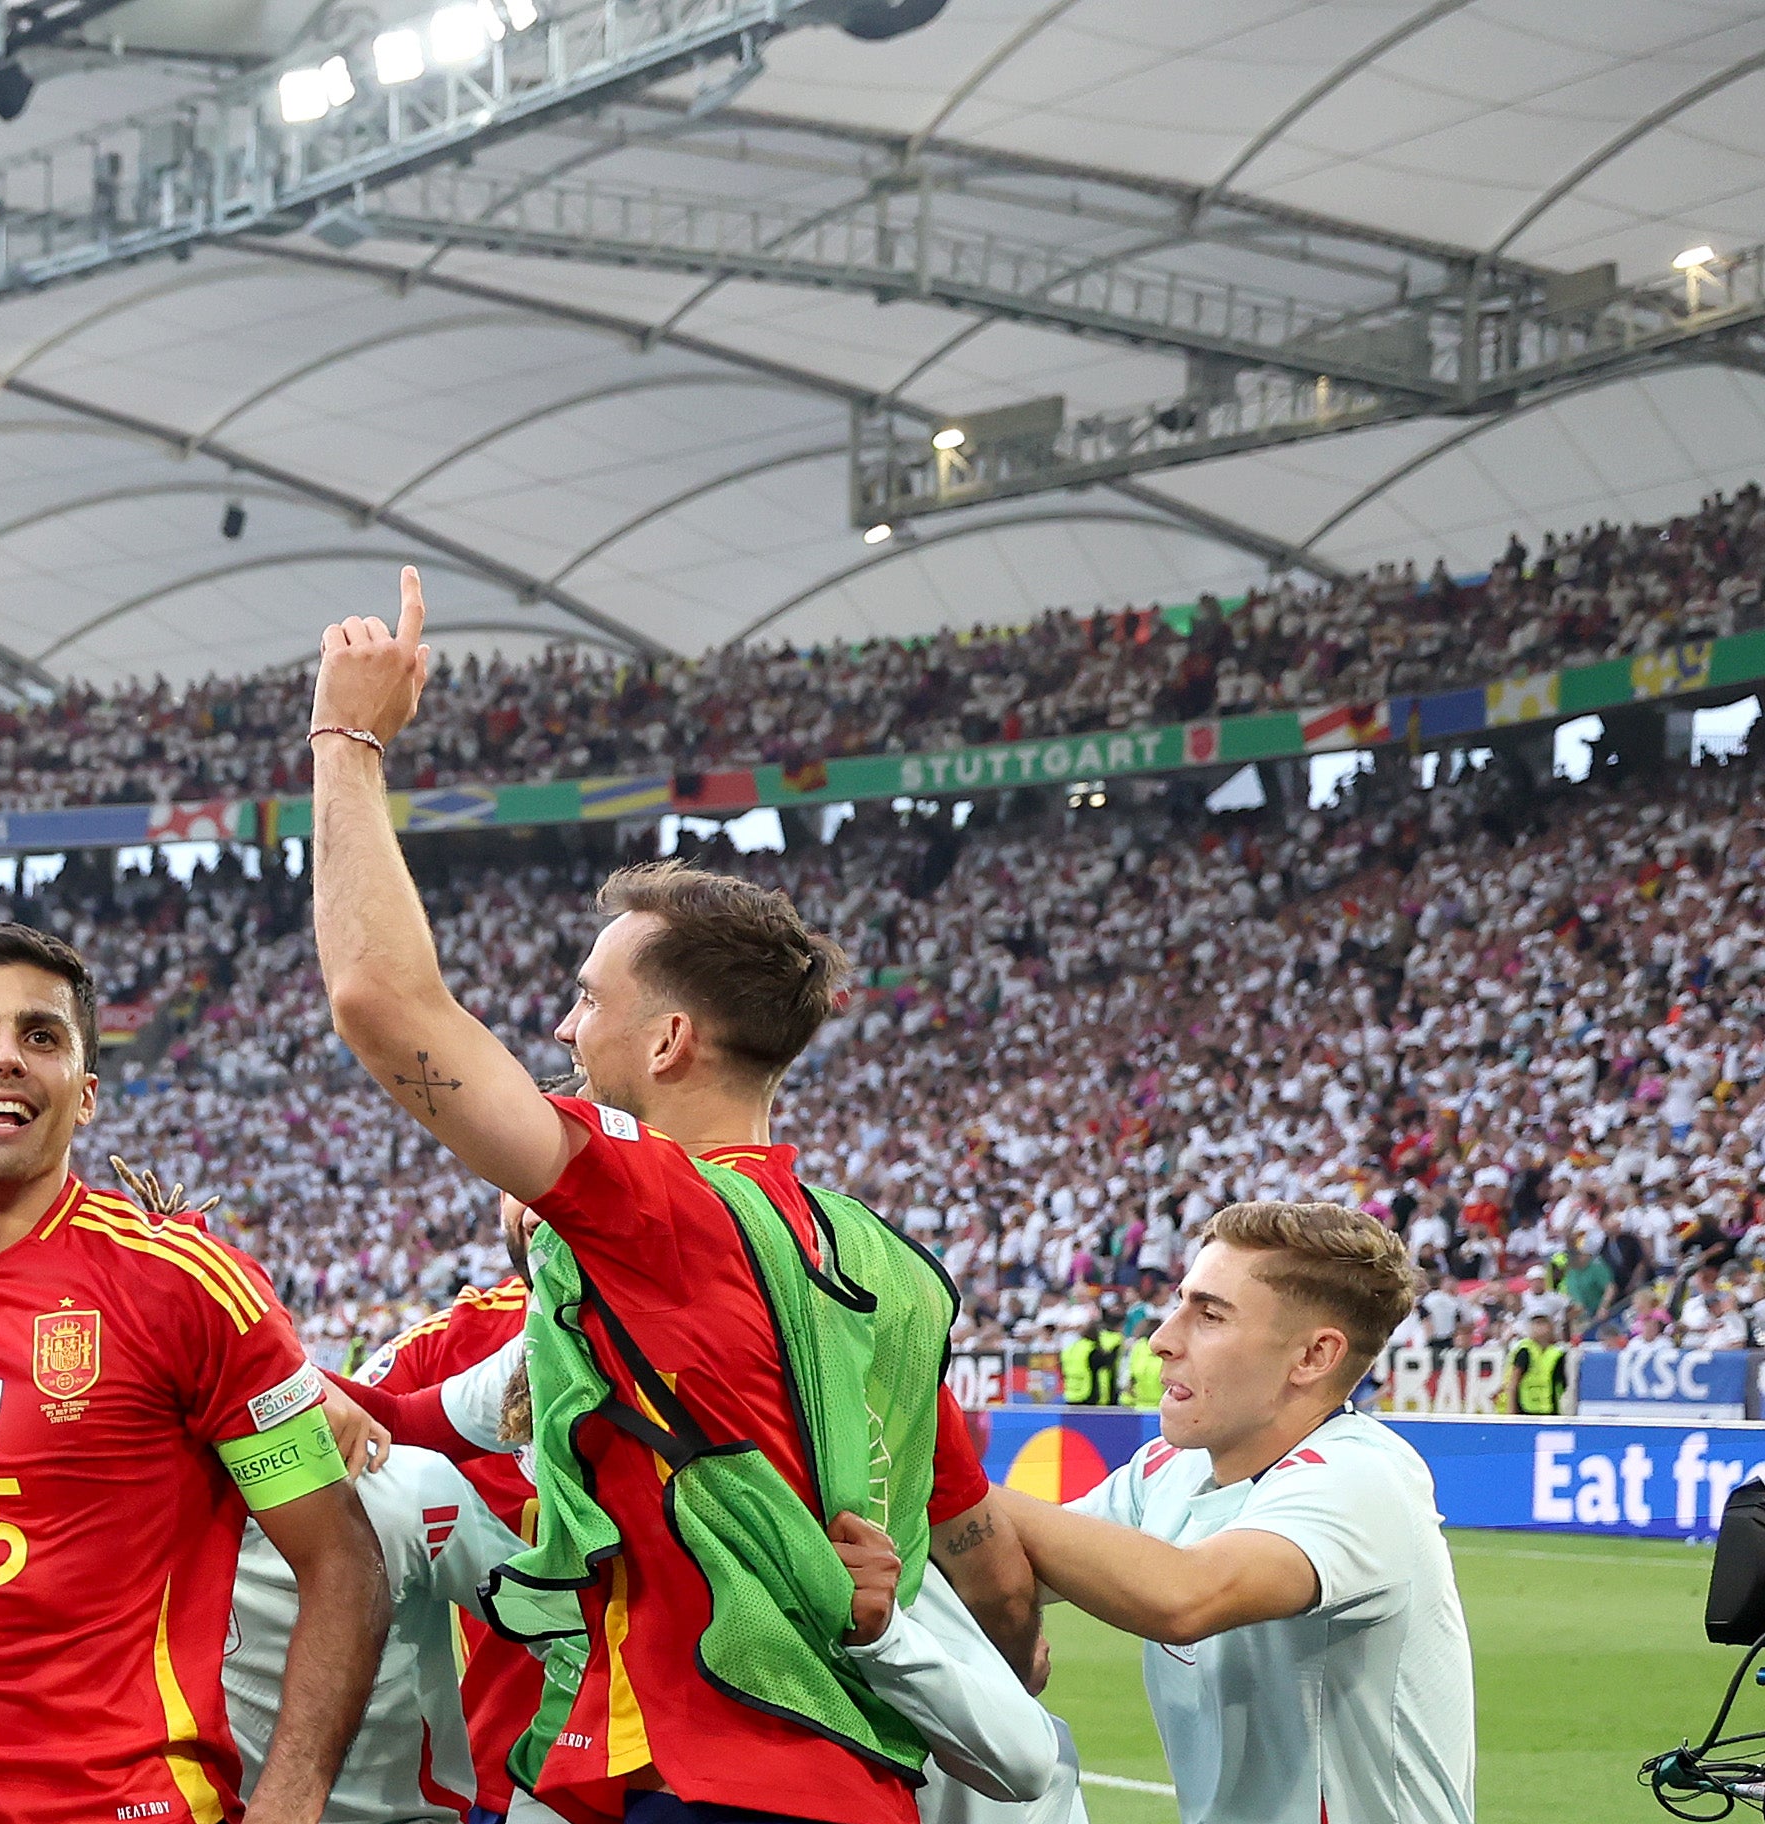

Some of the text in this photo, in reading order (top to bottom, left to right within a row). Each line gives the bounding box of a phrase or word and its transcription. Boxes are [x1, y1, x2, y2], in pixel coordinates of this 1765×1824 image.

[900, 731, 1163, 791] STUTTGART
[1613, 1346, 1714, 1401] KSC
[232, 1443, 301, 1482] RESPECT
[1532, 1431, 1653, 1527] Eat
[116, 1800, 170, 1821] HEAT.RDY
